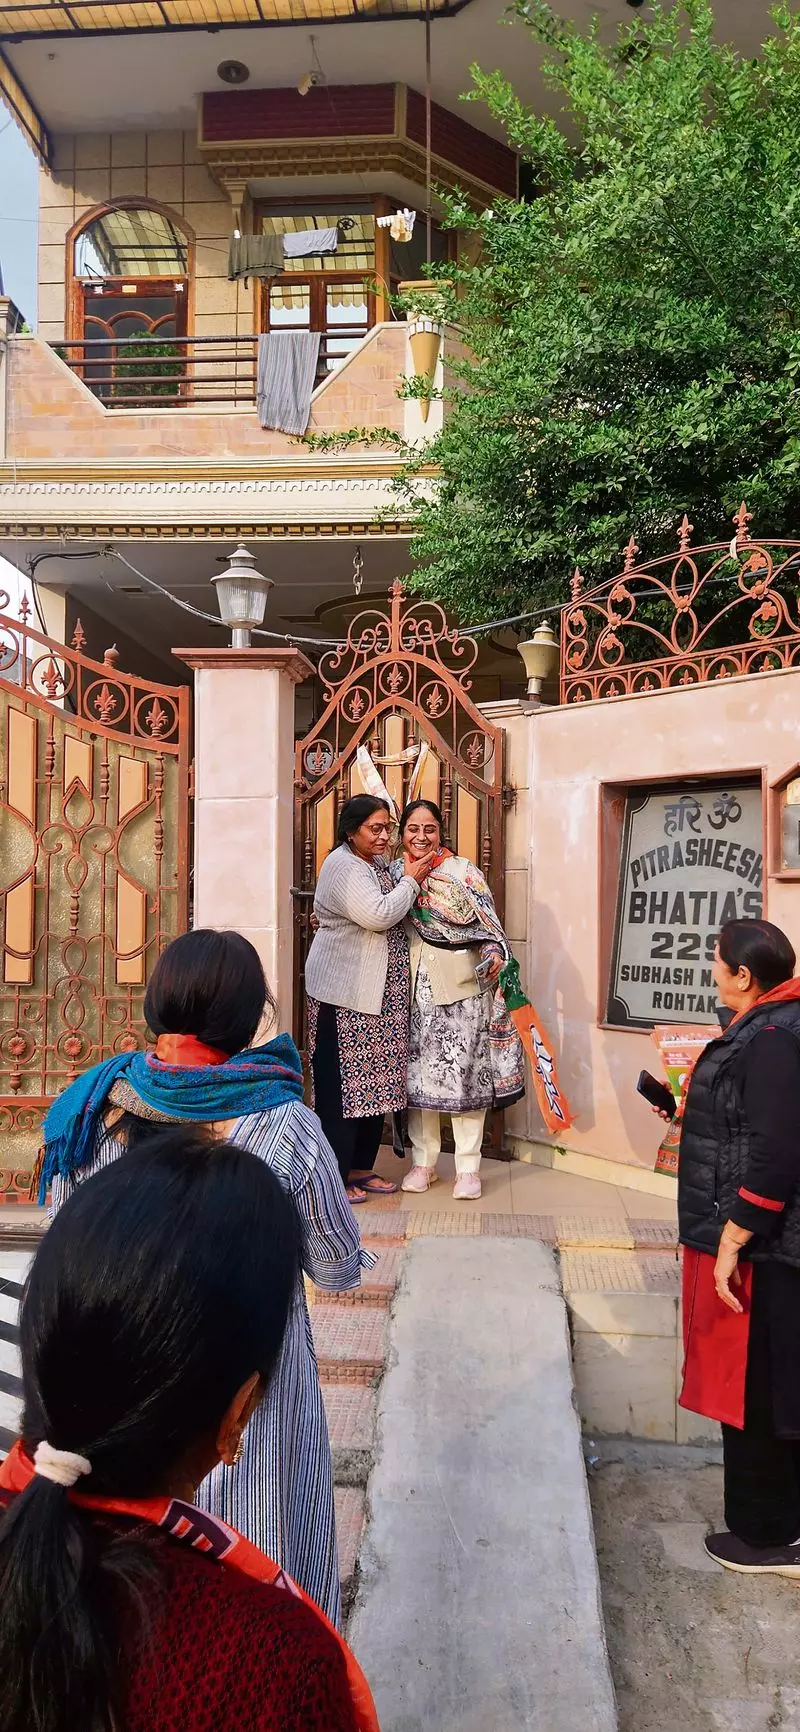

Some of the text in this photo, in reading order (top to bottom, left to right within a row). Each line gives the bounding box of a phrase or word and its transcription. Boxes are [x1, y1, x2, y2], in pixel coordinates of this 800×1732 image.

[663, 796, 704, 837] हरि
[630, 839, 763, 889] PITRASHEESH
[628, 887, 763, 925] BHATIA'S
[620, 964, 694, 986] SUBHASH
[652, 991, 718, 1013] ROHTAK
